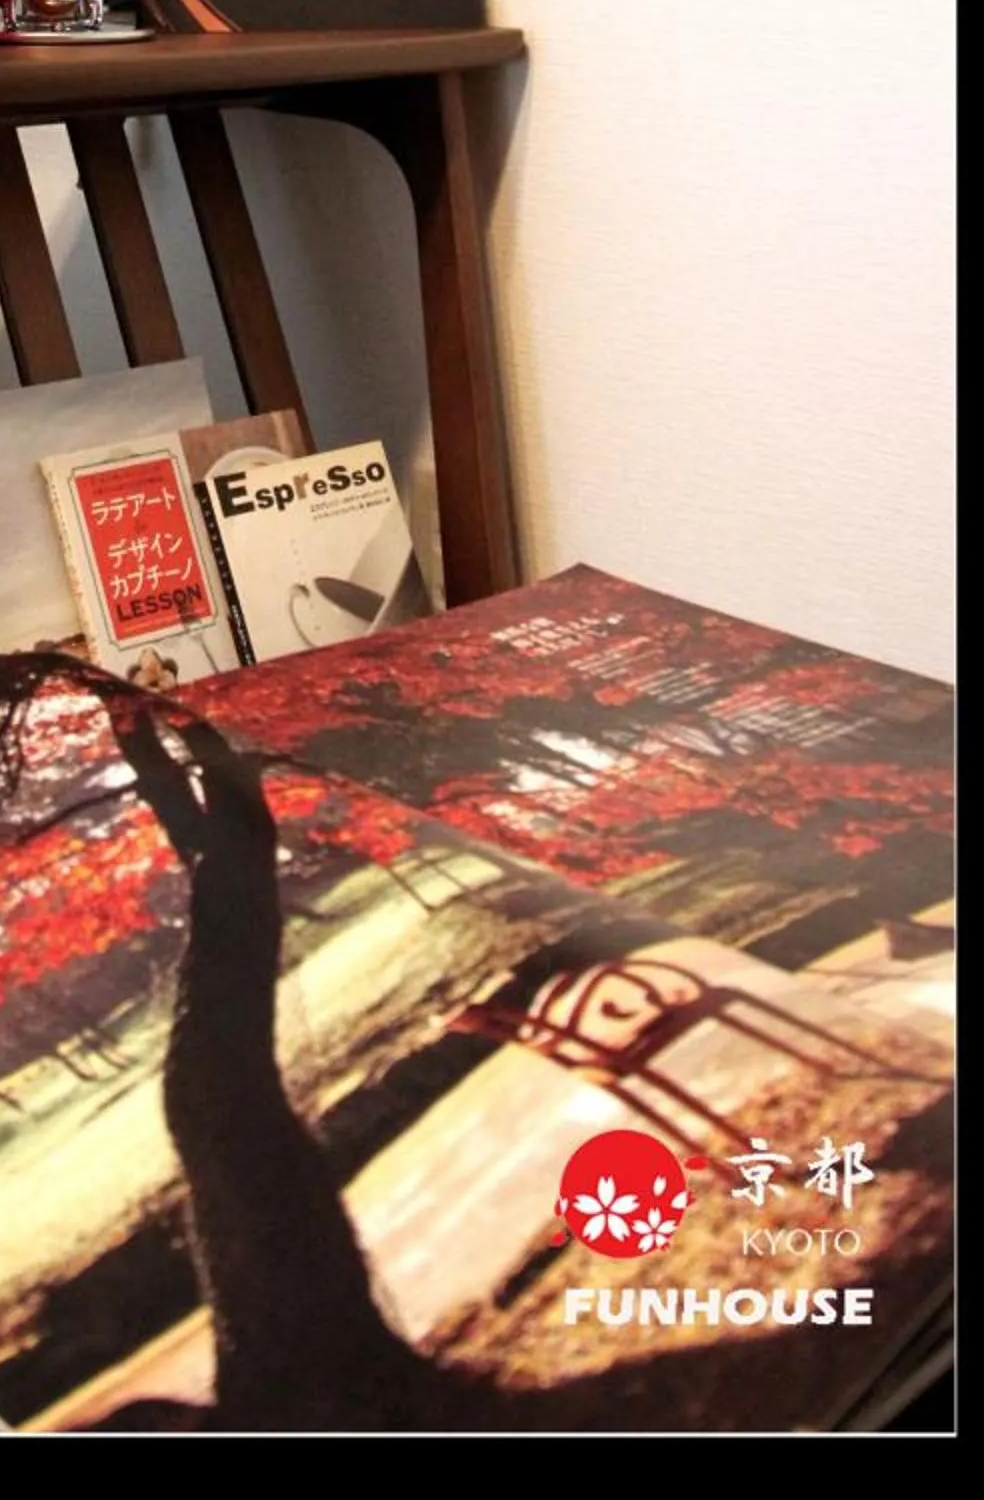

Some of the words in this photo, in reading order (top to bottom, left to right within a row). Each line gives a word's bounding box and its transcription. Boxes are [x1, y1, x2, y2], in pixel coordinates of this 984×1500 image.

[91, 486, 176, 526] ラテアート
[108, 533, 184, 569] デザイン
[116, 583, 202, 622] LESSON
